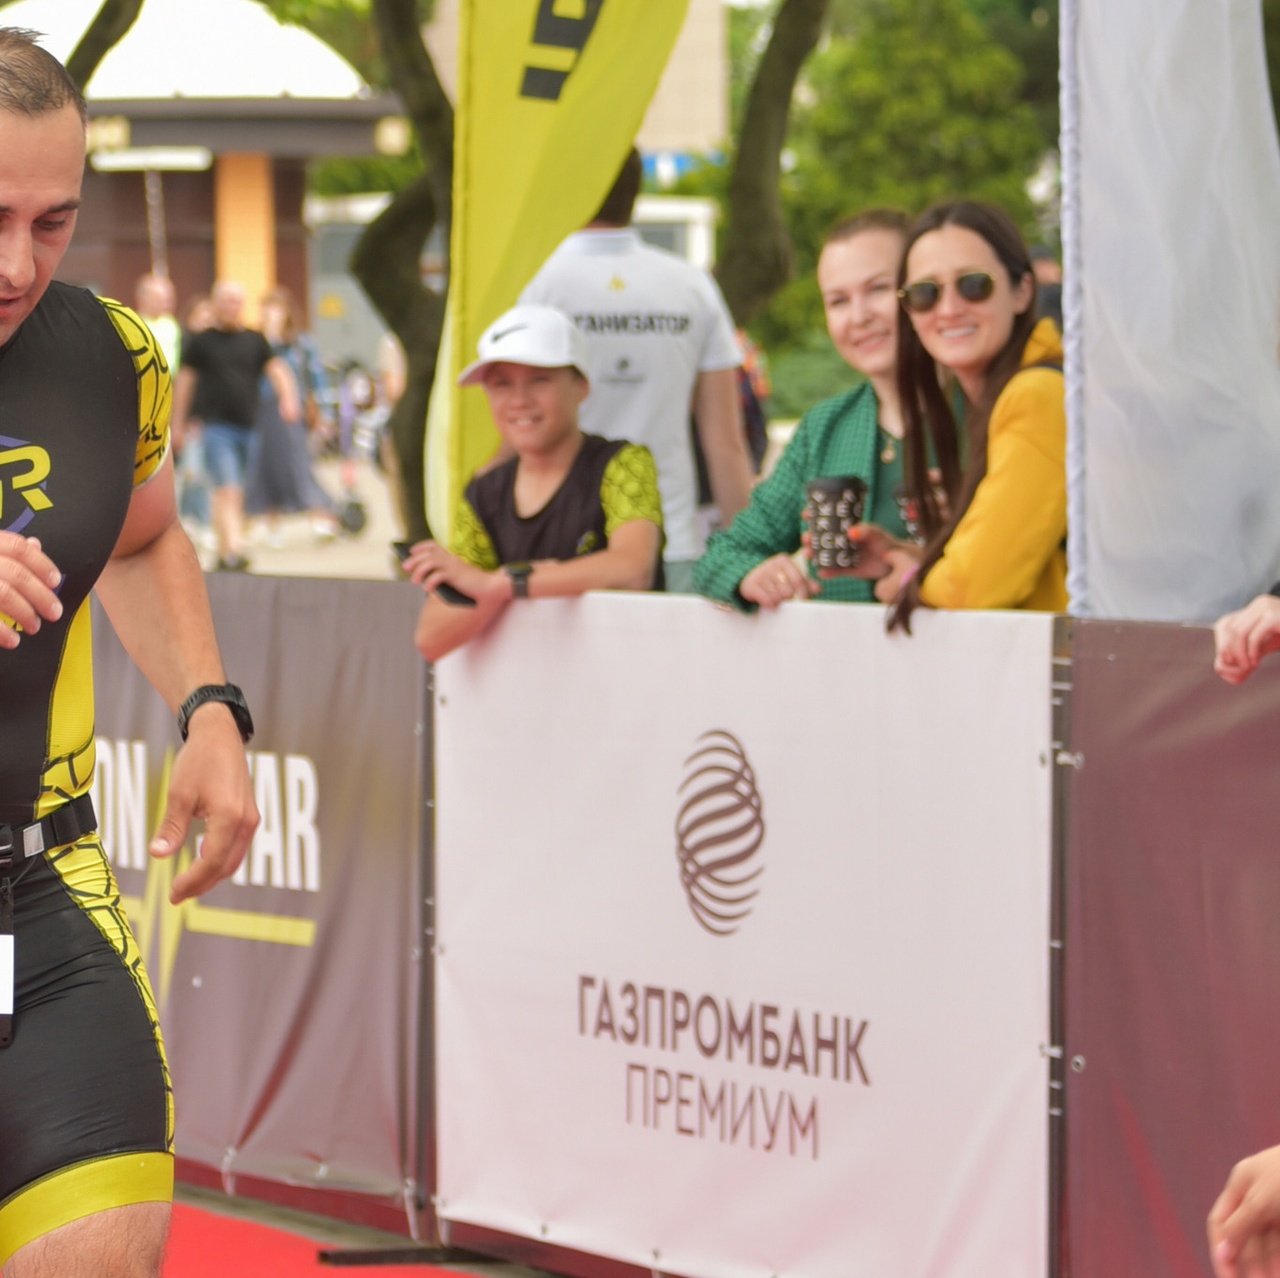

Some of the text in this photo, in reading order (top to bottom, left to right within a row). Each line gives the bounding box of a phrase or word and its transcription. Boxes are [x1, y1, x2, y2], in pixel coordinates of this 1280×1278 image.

[196, 751, 320, 893] AR
[576, 973, 871, 1088] ГАЗПРОМБАНК
[624, 1062, 819, 1161] ПРЕМИУМ
